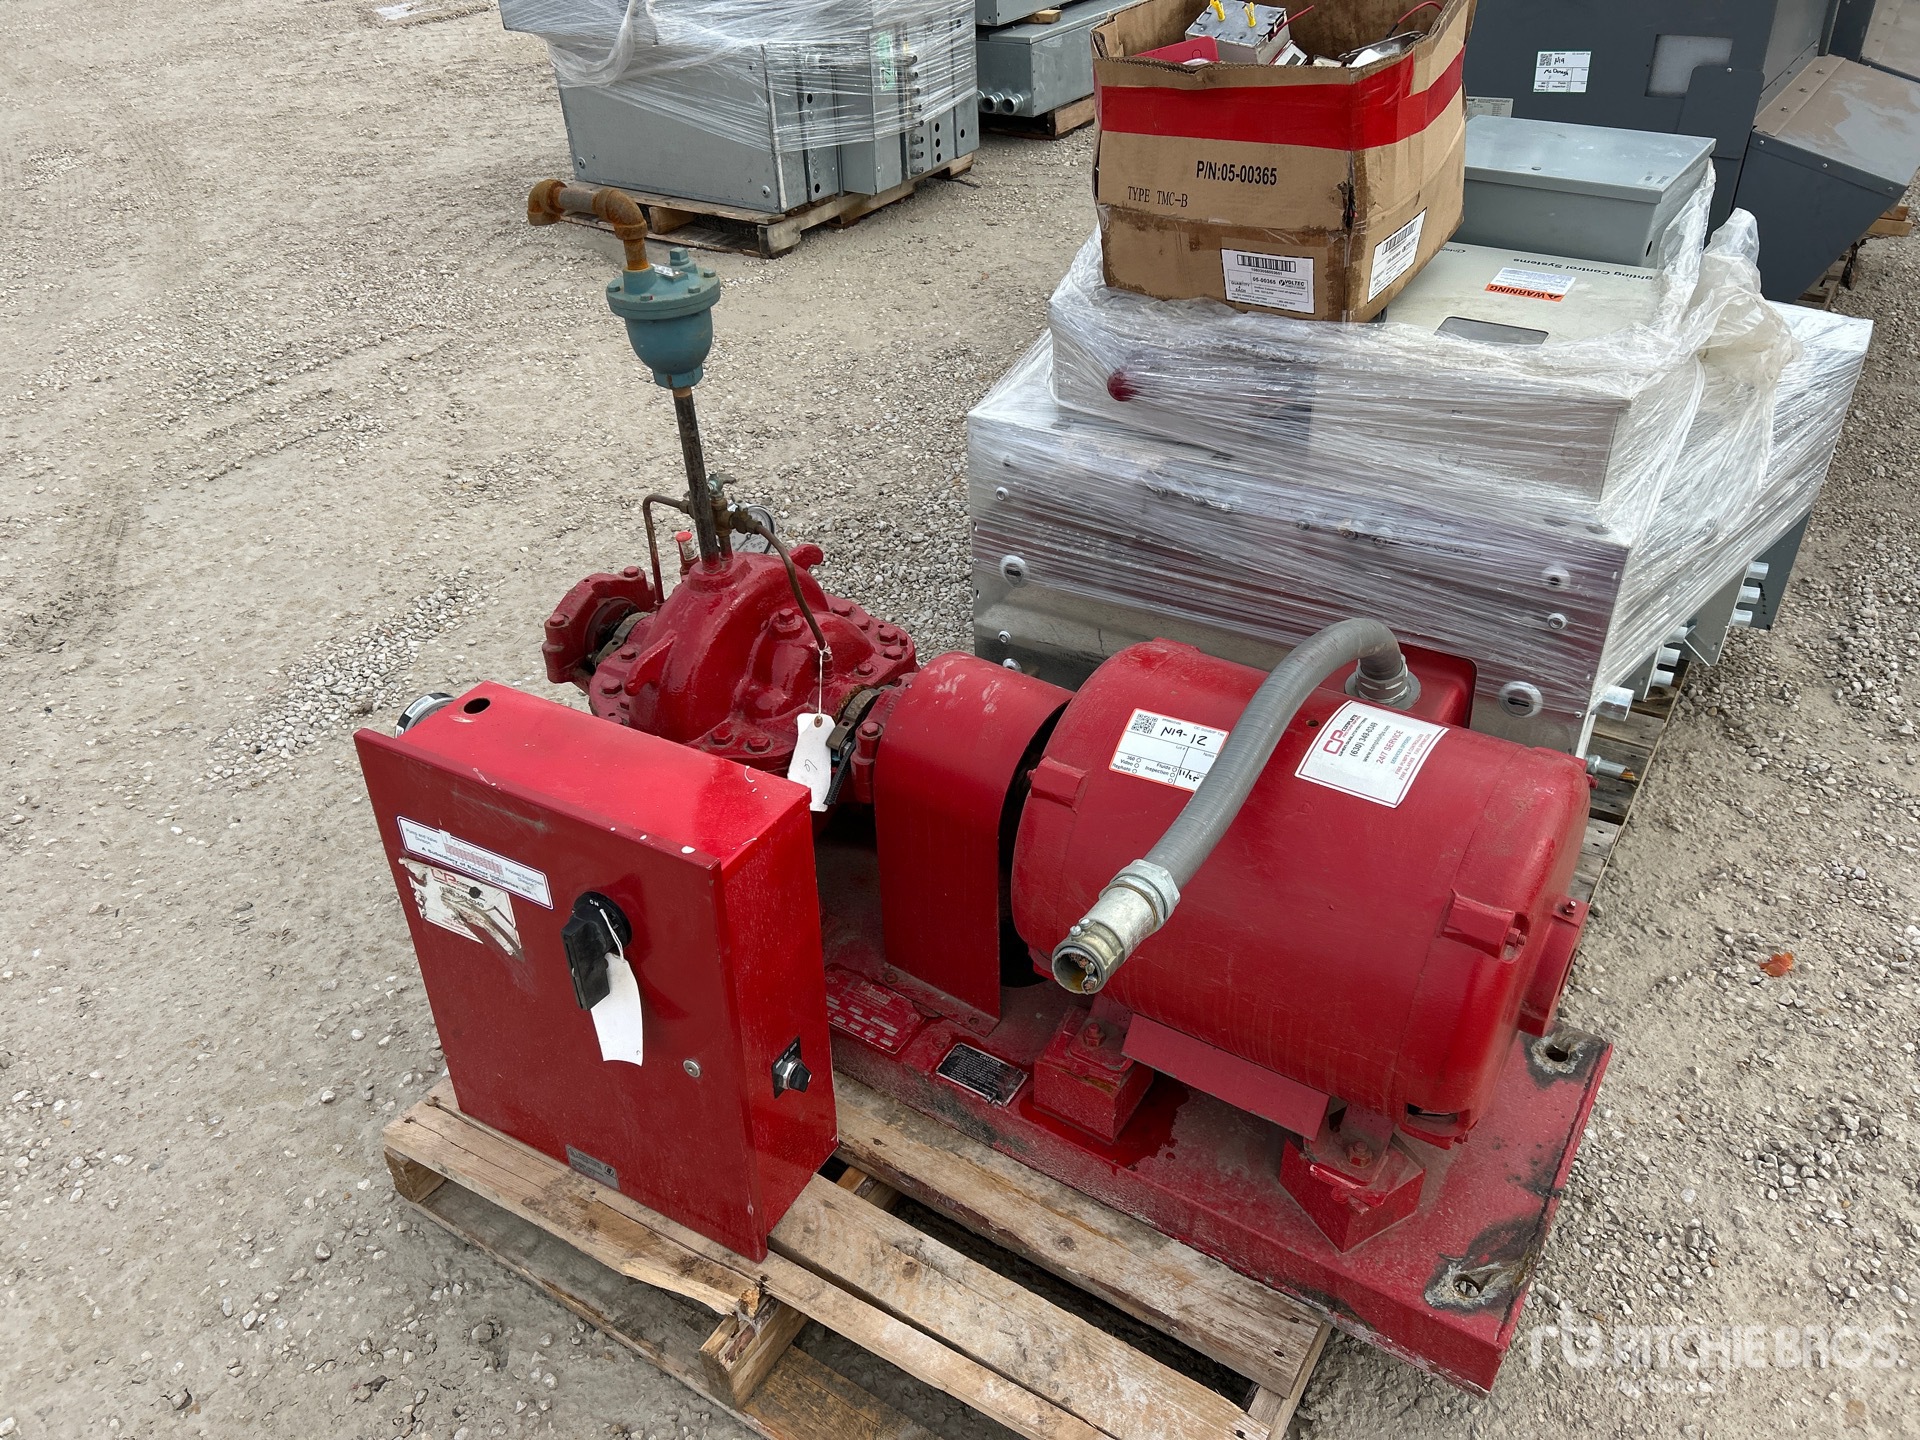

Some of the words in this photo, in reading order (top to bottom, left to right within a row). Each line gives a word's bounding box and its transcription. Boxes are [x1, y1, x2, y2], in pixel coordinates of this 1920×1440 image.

[1197, 160, 1277, 185] P/N:05-00365
[1128, 186, 1150, 202] TYPE
[1157, 190, 1188, 208] TMC-B
[1513, 258, 1562, 269] Systems
[1566, 265, 1610, 275] Control
[1614, 272, 1653, 280] ghting
[1490, 285, 1544, 298] WARNING
[1341, 714, 1358, 732] COMPLETE
[1350, 742, 1365, 757] (630)
[1359, 722, 1378, 743] 349-0349
[1376, 751, 1389, 764] 24/7
[1386, 730, 1403, 751] SERVICE
[1145, 766, 1169, 776] Inspection
[428, 849, 458, 864] Subsidiary
[589, 899, 599, 907] ON
[979, 1054, 1001, 1067] CAUTION
